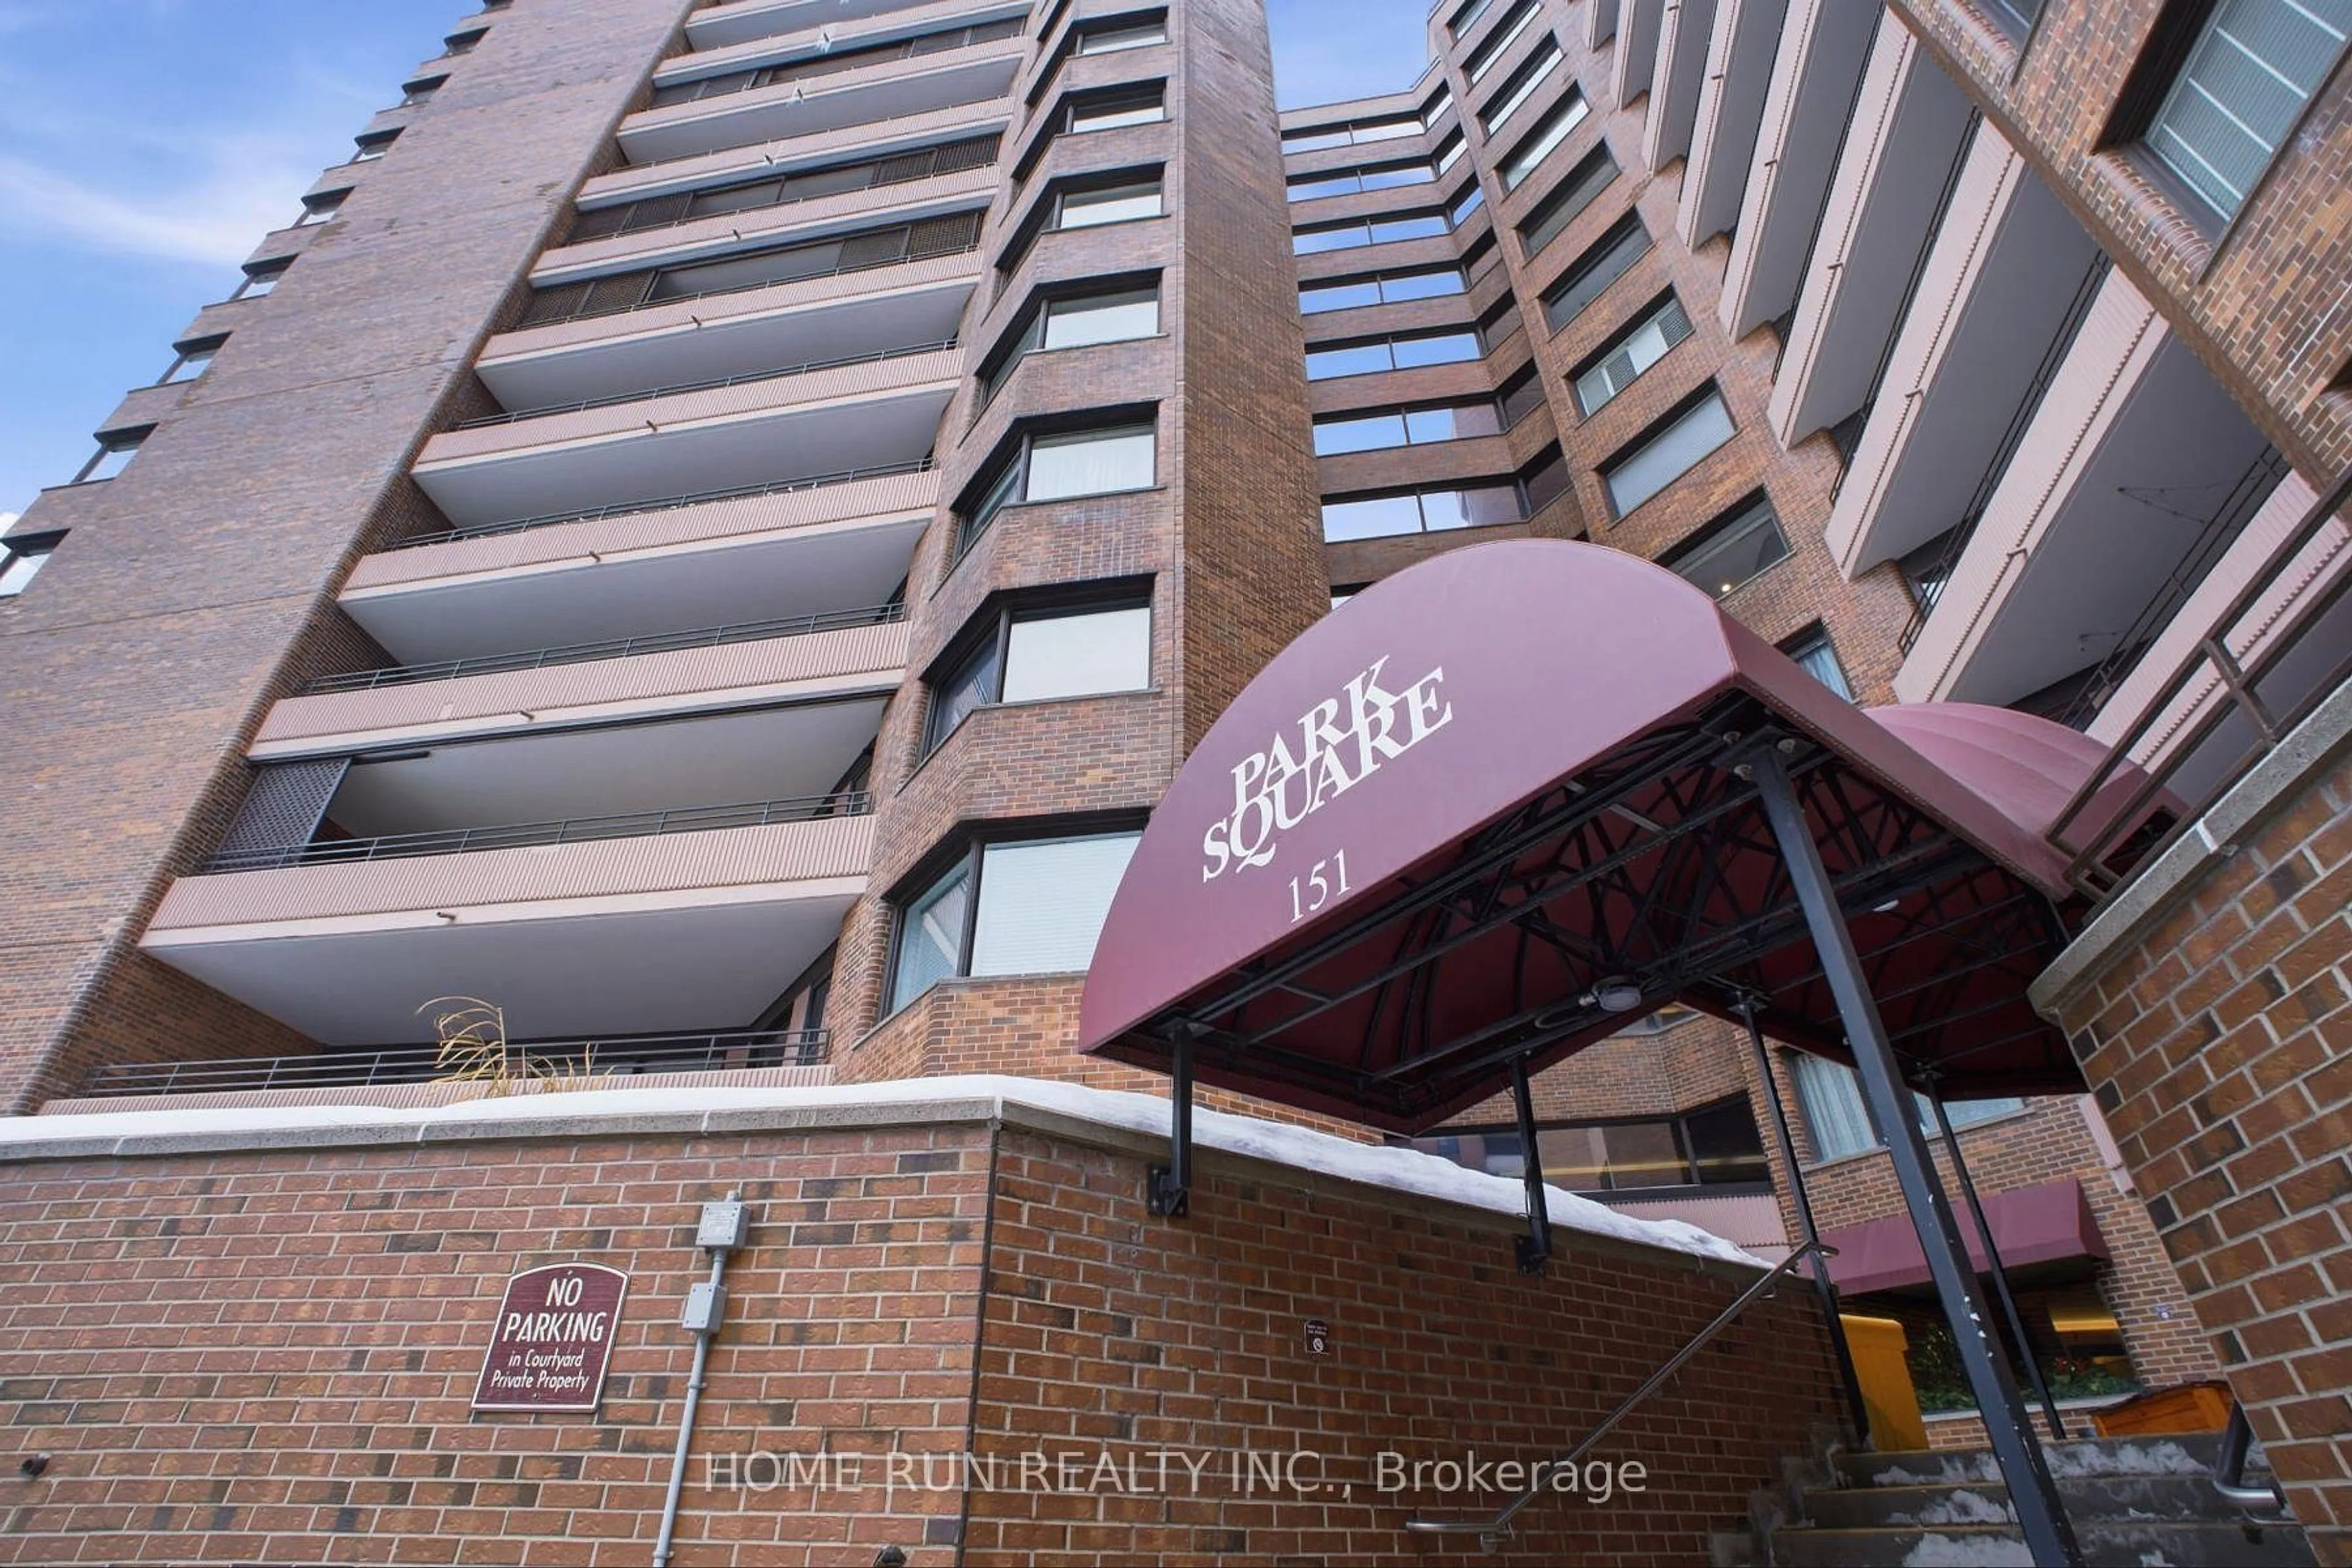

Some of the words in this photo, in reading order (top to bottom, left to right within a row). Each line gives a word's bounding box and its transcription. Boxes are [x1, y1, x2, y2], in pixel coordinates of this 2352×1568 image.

[1231, 654, 1398, 818] PARK
[1202, 665, 1453, 884] SQUARE
[1288, 847, 1352, 924] 151
[545, 1276, 583, 1307] NO
[502, 1311, 607, 1343] PARKING
[508, 1351, 521, 1368] in
[524, 1349, 585, 1371] Courtyard
[491, 1370, 534, 1389] Private
[537, 1371, 590, 1392] Property
